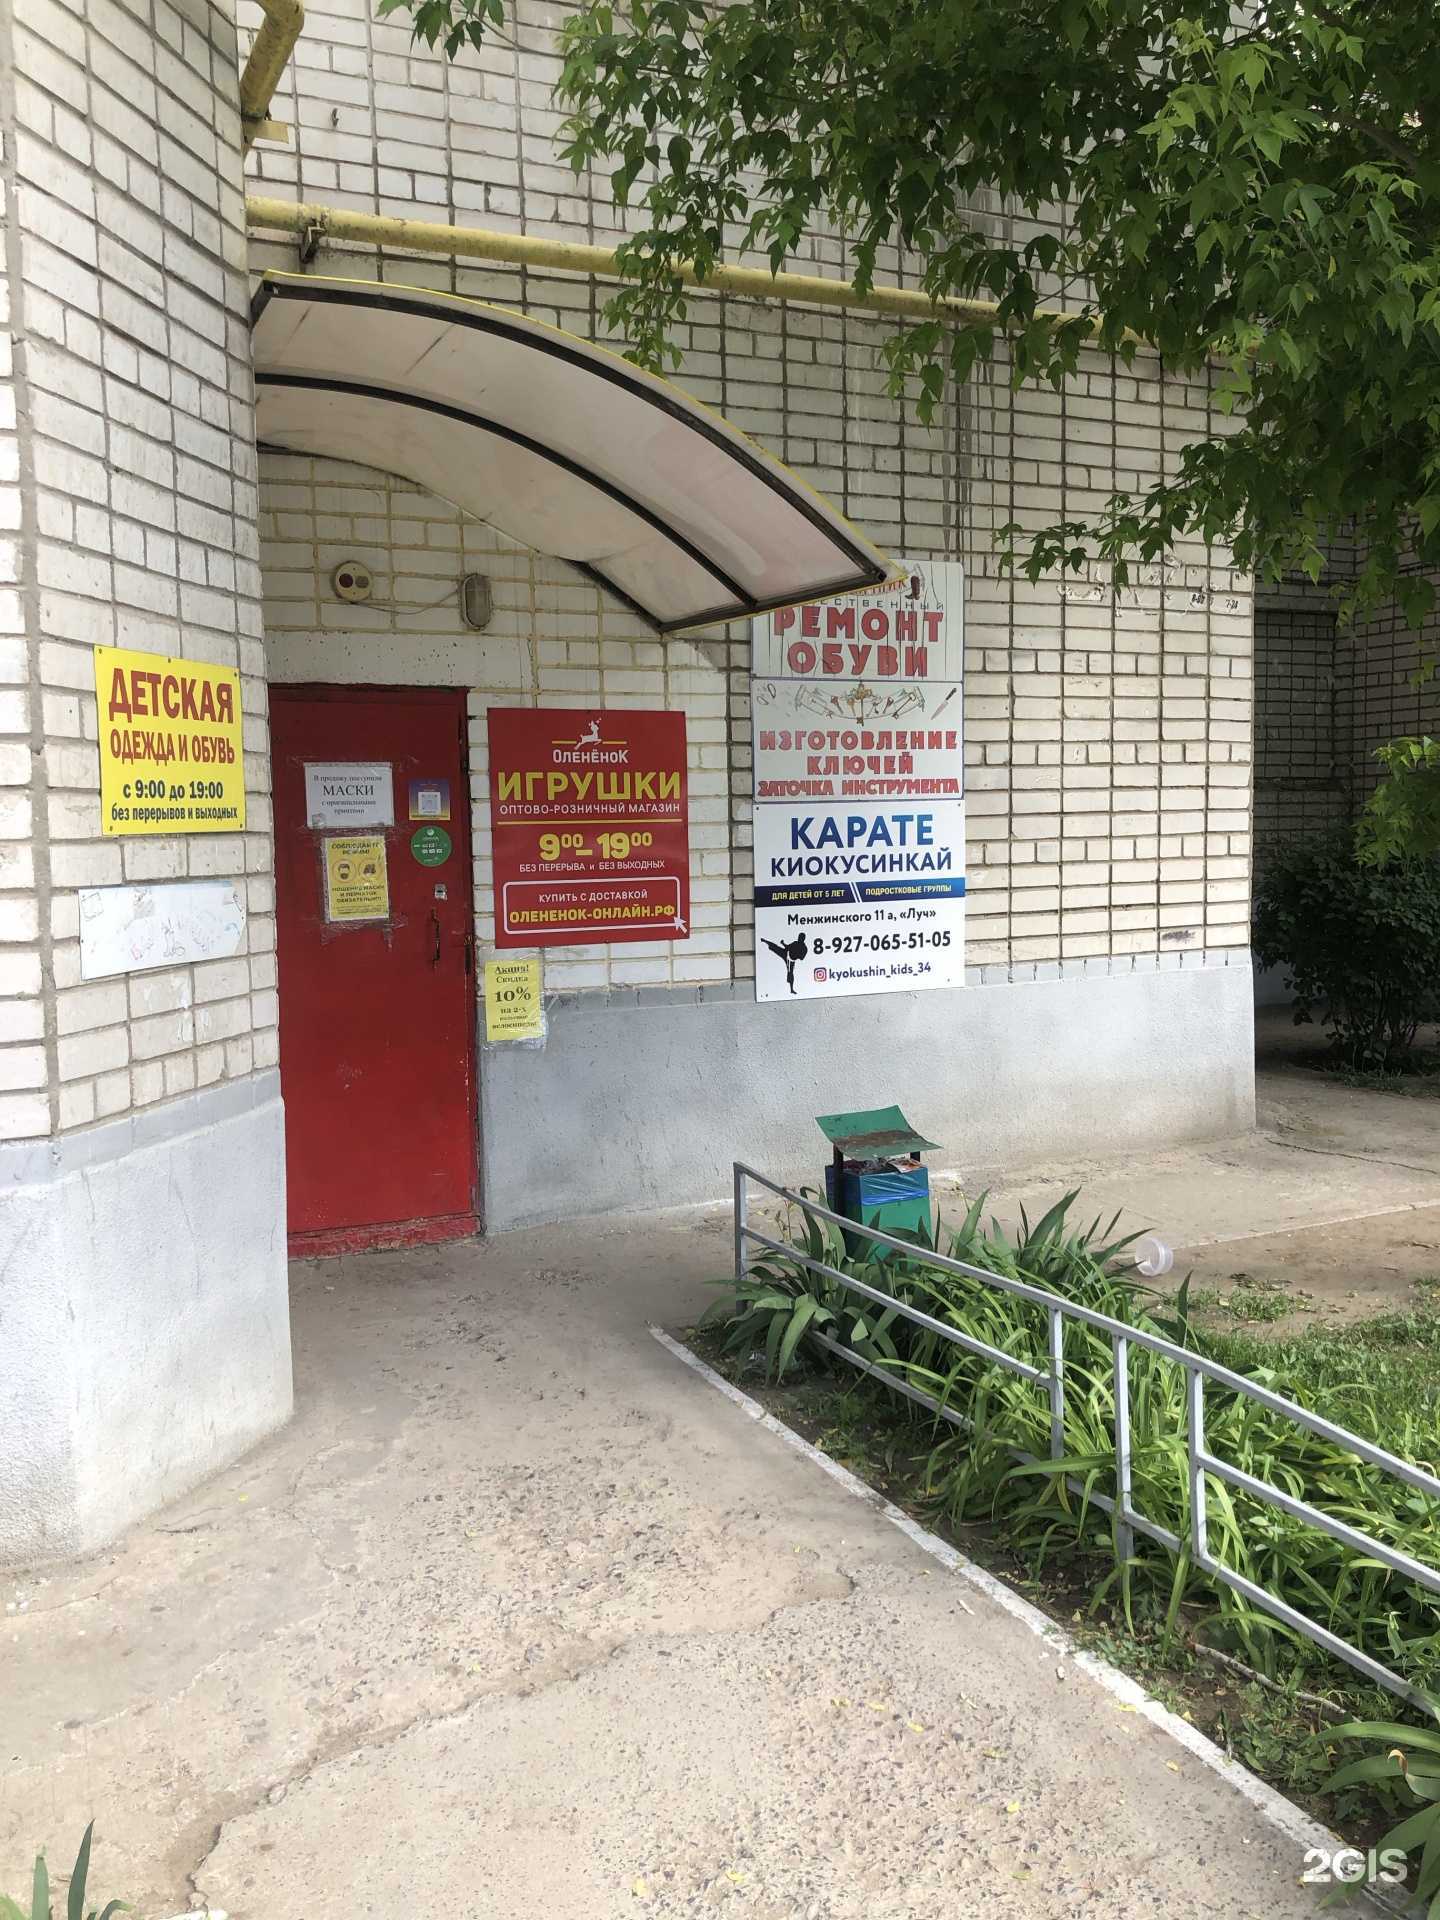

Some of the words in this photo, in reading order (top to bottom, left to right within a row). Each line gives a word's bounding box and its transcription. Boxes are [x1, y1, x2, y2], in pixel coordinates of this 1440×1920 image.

[773, 606, 944, 642] РЕМОНТ
[787, 641, 928, 677] ОБУВИ
[108, 667, 234, 724] ДЕТСКАЯ
[110, 728, 176, 766] ОДЕЖДА
[178, 734, 188, 762] И
[191, 735, 235, 764] ОБУВЬ
[759, 730, 958, 751] ИЗГОТОВЛЕНИЕ
[807, 751, 914, 775] КЛЮЧЕЙ
[135, 779, 166, 799] 9:00
[169, 784, 186, 801] до
[189, 780, 224, 799] 19:00
[323, 784, 374, 796] МАСКИ
[497, 771, 681, 801] ИГРУШКИ
[757, 780, 834, 797] ЗАТОЧКА
[841, 778, 960, 795] ИНСТРУМЕНТА
[111, 802, 130, 821] без
[132, 807, 185, 824] перерывов
[188, 807, 193, 819] и
[195, 807, 238, 822] выходных
[500, 802, 625, 815] ОПТОВО-РОЗНИЧНЫЙ
[628, 803, 680, 814] МАГАЗИН
[791, 814, 934, 850] КАРАТЕ
[519, 863, 537, 873] БЕЗ
[538, 862, 586, 872] ПЕРЕРЫВА
[599, 861, 615, 870] БЕЗ
[617, 860, 665, 871] ВЫХОДНЫХ
[771, 847, 952, 877] КИОКУСИНКАЙ
[538, 892, 578, 903] КУПИТЬ
[580, 892, 587, 901] С
[589, 889, 648, 902] ДОСТАВКОЙ
[772, 892, 788, 901] ДЛЯ
[789, 889, 812, 900] ДЕТЕЙ
[813, 890, 824, 898] ОТ
[831, 889, 845, 897] ЛЕТ
[865, 885, 922, 896] ПОДРОСТКОВЫЕ
[923, 884, 952, 893] ГРУППЫ
[509, 904, 675, 924] ОЛЕНЕНОК-ОНЛАЙН.РФ
[787, 913, 872, 926] Менжинского
[900, 907, 937, 921] «Луч»
[813, 930, 951, 955] 8-927-065-51-05
[828, 962, 931, 980] kyokushin_kids_34
[495, 986, 531, 1003] 10%
